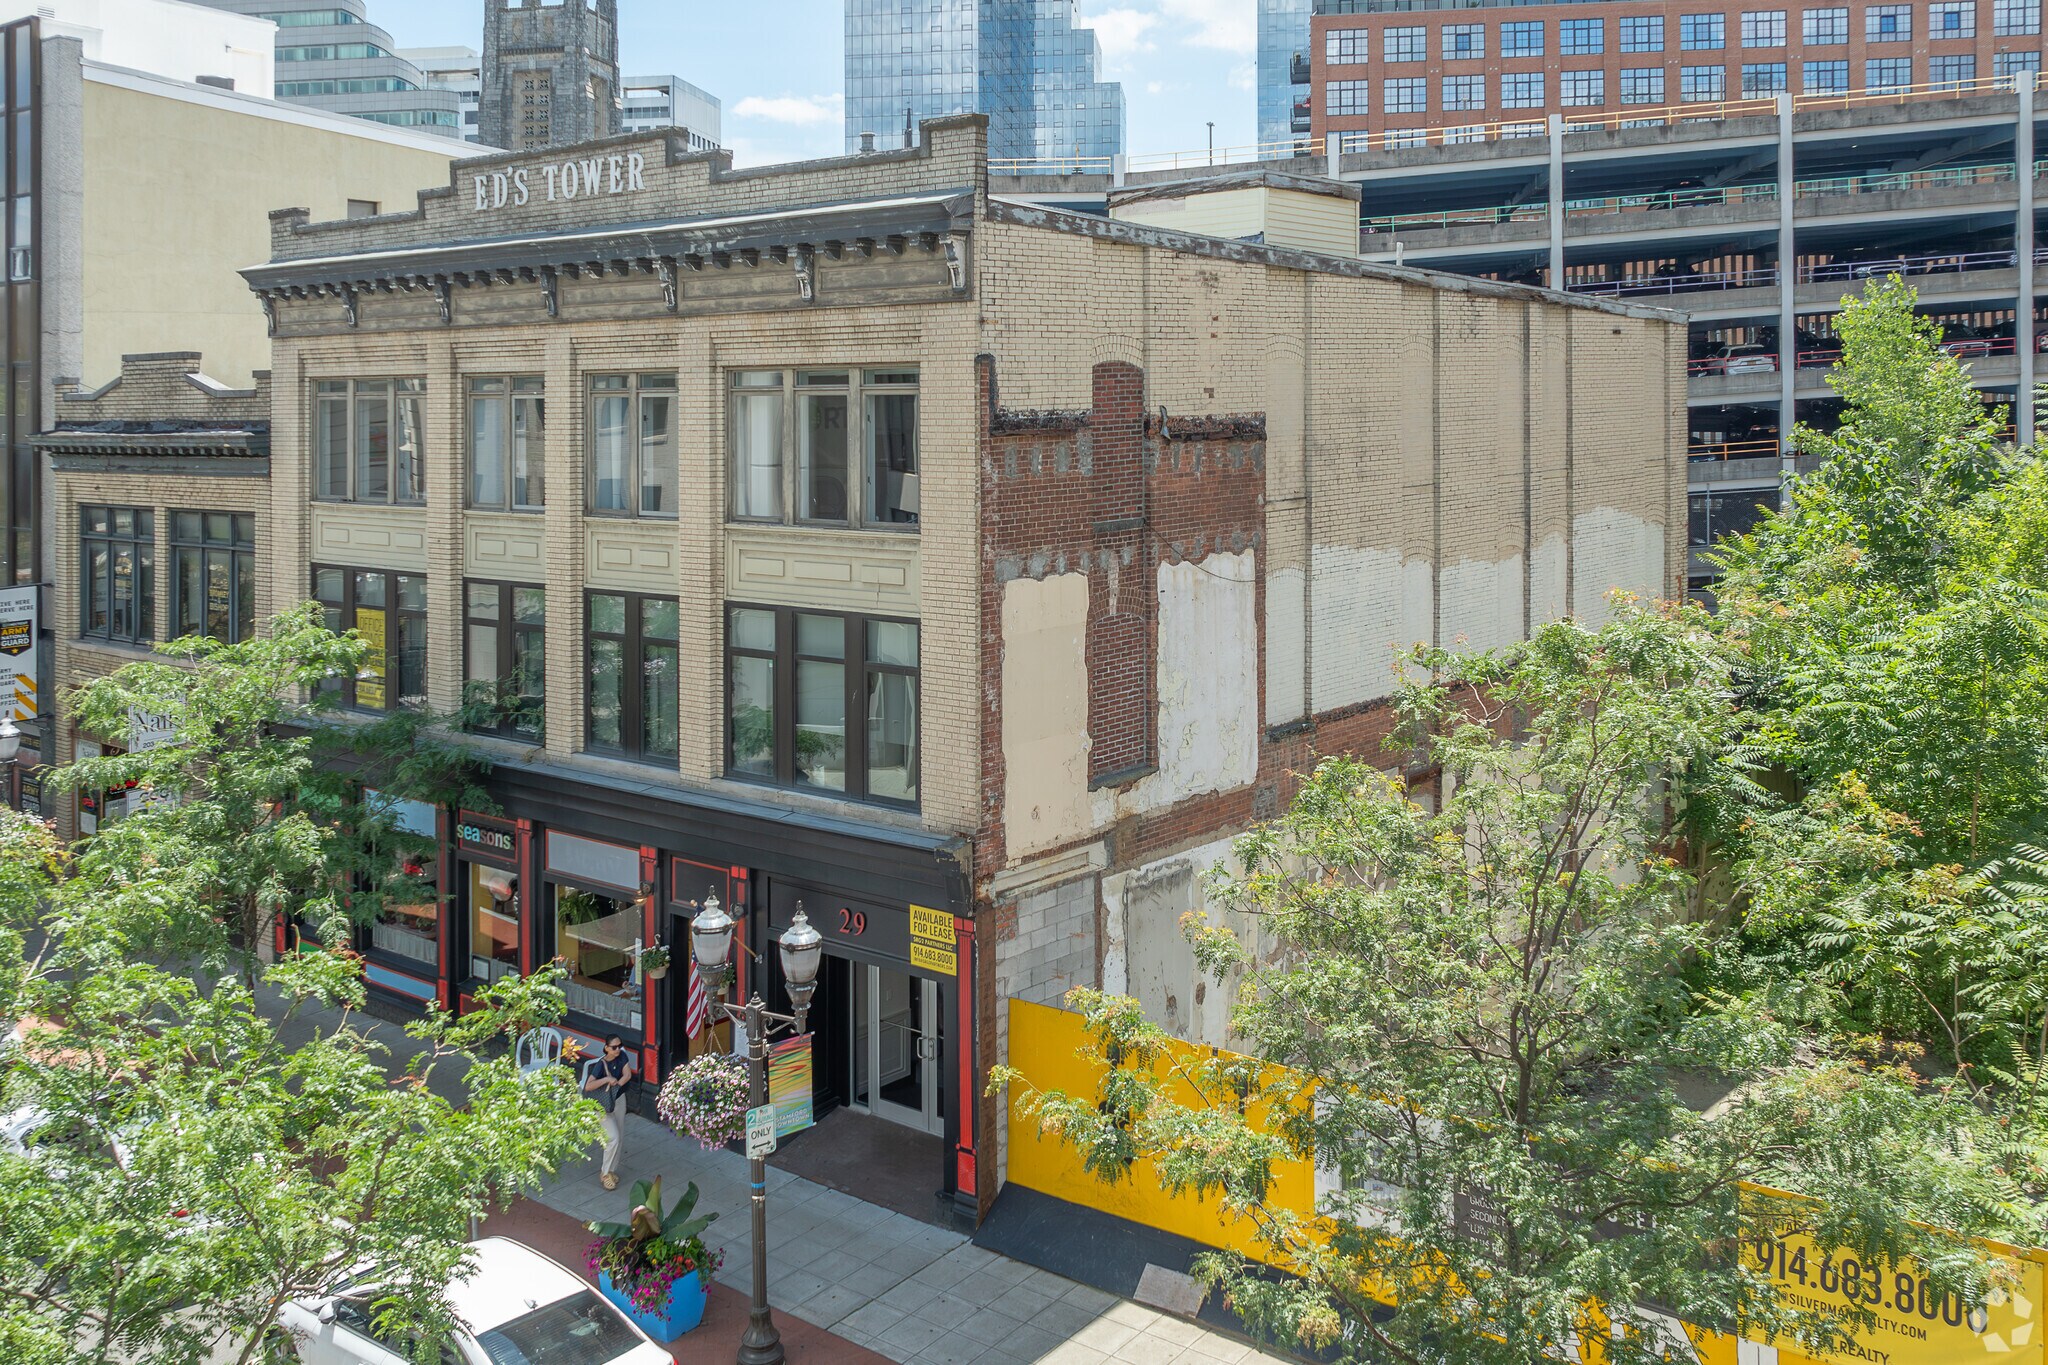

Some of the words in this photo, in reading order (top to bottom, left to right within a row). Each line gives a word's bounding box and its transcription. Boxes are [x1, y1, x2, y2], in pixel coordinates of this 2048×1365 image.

[474, 166, 529, 211] ED'S
[543, 153, 646, 201] TOWER
[1, 626, 29, 636] ARMY
[1, 638, 29, 647] GUARD
[457, 823, 511, 850] seasons
[839, 908, 866, 936] 29
[913, 910, 952, 928] AVAILABLE
[913, 921, 928, 935] FOR
[929, 925, 952, 940] LEASE
[913, 946, 953, 965] 914.683.8000
[748, 1114, 756, 1126] 2
[776, 1114, 809, 1127] OWNTOWN
[751, 1127, 771, 1140] ONLY
